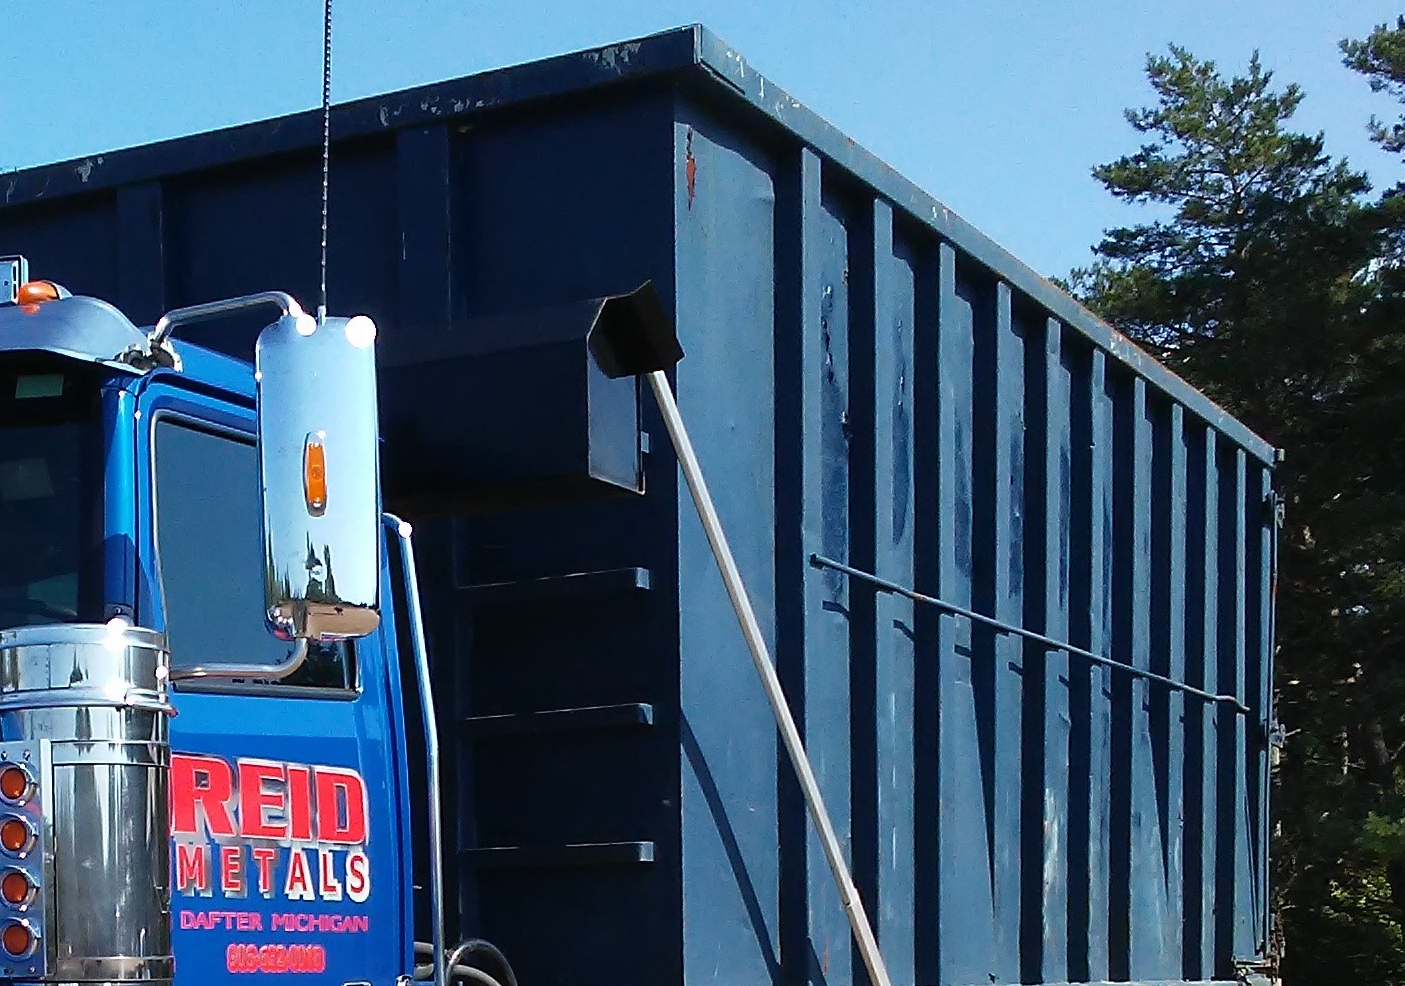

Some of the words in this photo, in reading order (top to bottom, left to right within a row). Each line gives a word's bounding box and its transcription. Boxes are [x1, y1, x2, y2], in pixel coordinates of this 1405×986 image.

[168, 752, 369, 846] REID
[175, 844, 370, 902] METALS
[179, 910, 263, 932] DAFTER
[271, 912, 369, 934] MICHIGAN
